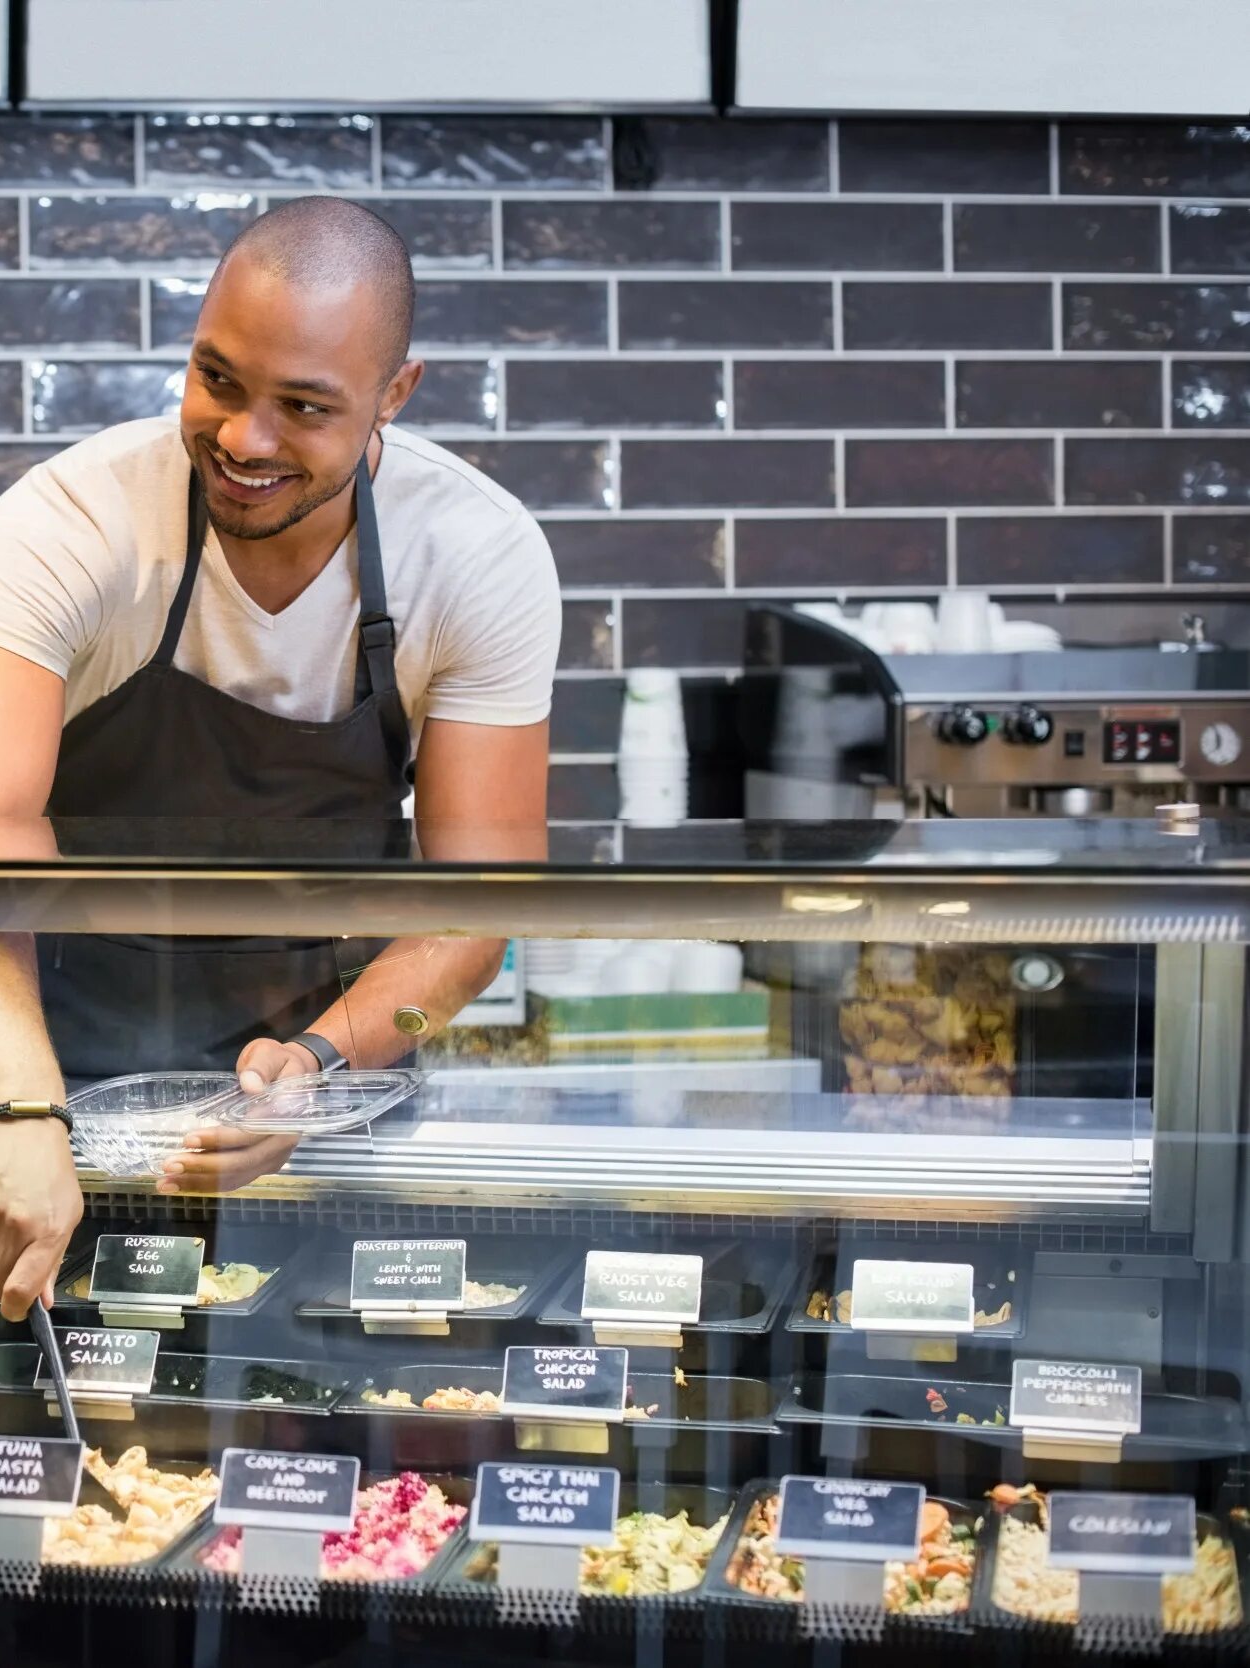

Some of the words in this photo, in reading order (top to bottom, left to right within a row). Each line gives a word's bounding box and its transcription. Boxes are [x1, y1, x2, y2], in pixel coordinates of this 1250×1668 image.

[124, 1237, 176, 1249] RUSSIAN
[354, 1242, 401, 1252] ROASTED
[402, 1241, 465, 1252] BUTTERNUT
[136, 1250, 160, 1261] EGG
[128, 1263, 165, 1275] SALAD
[378, 1264, 413, 1274] LENTIL
[415, 1264, 442, 1274] WITH
[373, 1275, 408, 1286] SWEET
[409, 1275, 442, 1286] CHILLI
[598, 1272, 650, 1287] RAOST
[654, 1274, 689, 1288] VEG
[617, 1290, 667, 1305] SALAD
[884, 1290, 939, 1305] SALAD
[64, 1331, 138, 1348] POTATO
[69, 1350, 126, 1366] SALAD
[533, 1348, 601, 1361] TROPICAL
[534, 1363, 597, 1376] CHICKEN
[541, 1377, 587, 1390] SALAD
[1022, 1377, 1094, 1393] PEPPERS
[1096, 1381, 1133, 1395] WITH
[244, 1454, 338, 1475] COUS-COUS
[271, 1471, 306, 1488] AND
[496, 1466, 554, 1487] SPICY
[558, 1469, 601, 1488] THAI
[245, 1484, 328, 1505] BEETROOT
[505, 1485, 590, 1507] CHICKEN
[832, 1495, 869, 1512] VEG
[515, 1504, 576, 1525] SALAD
[822, 1509, 875, 1527] SALAD
